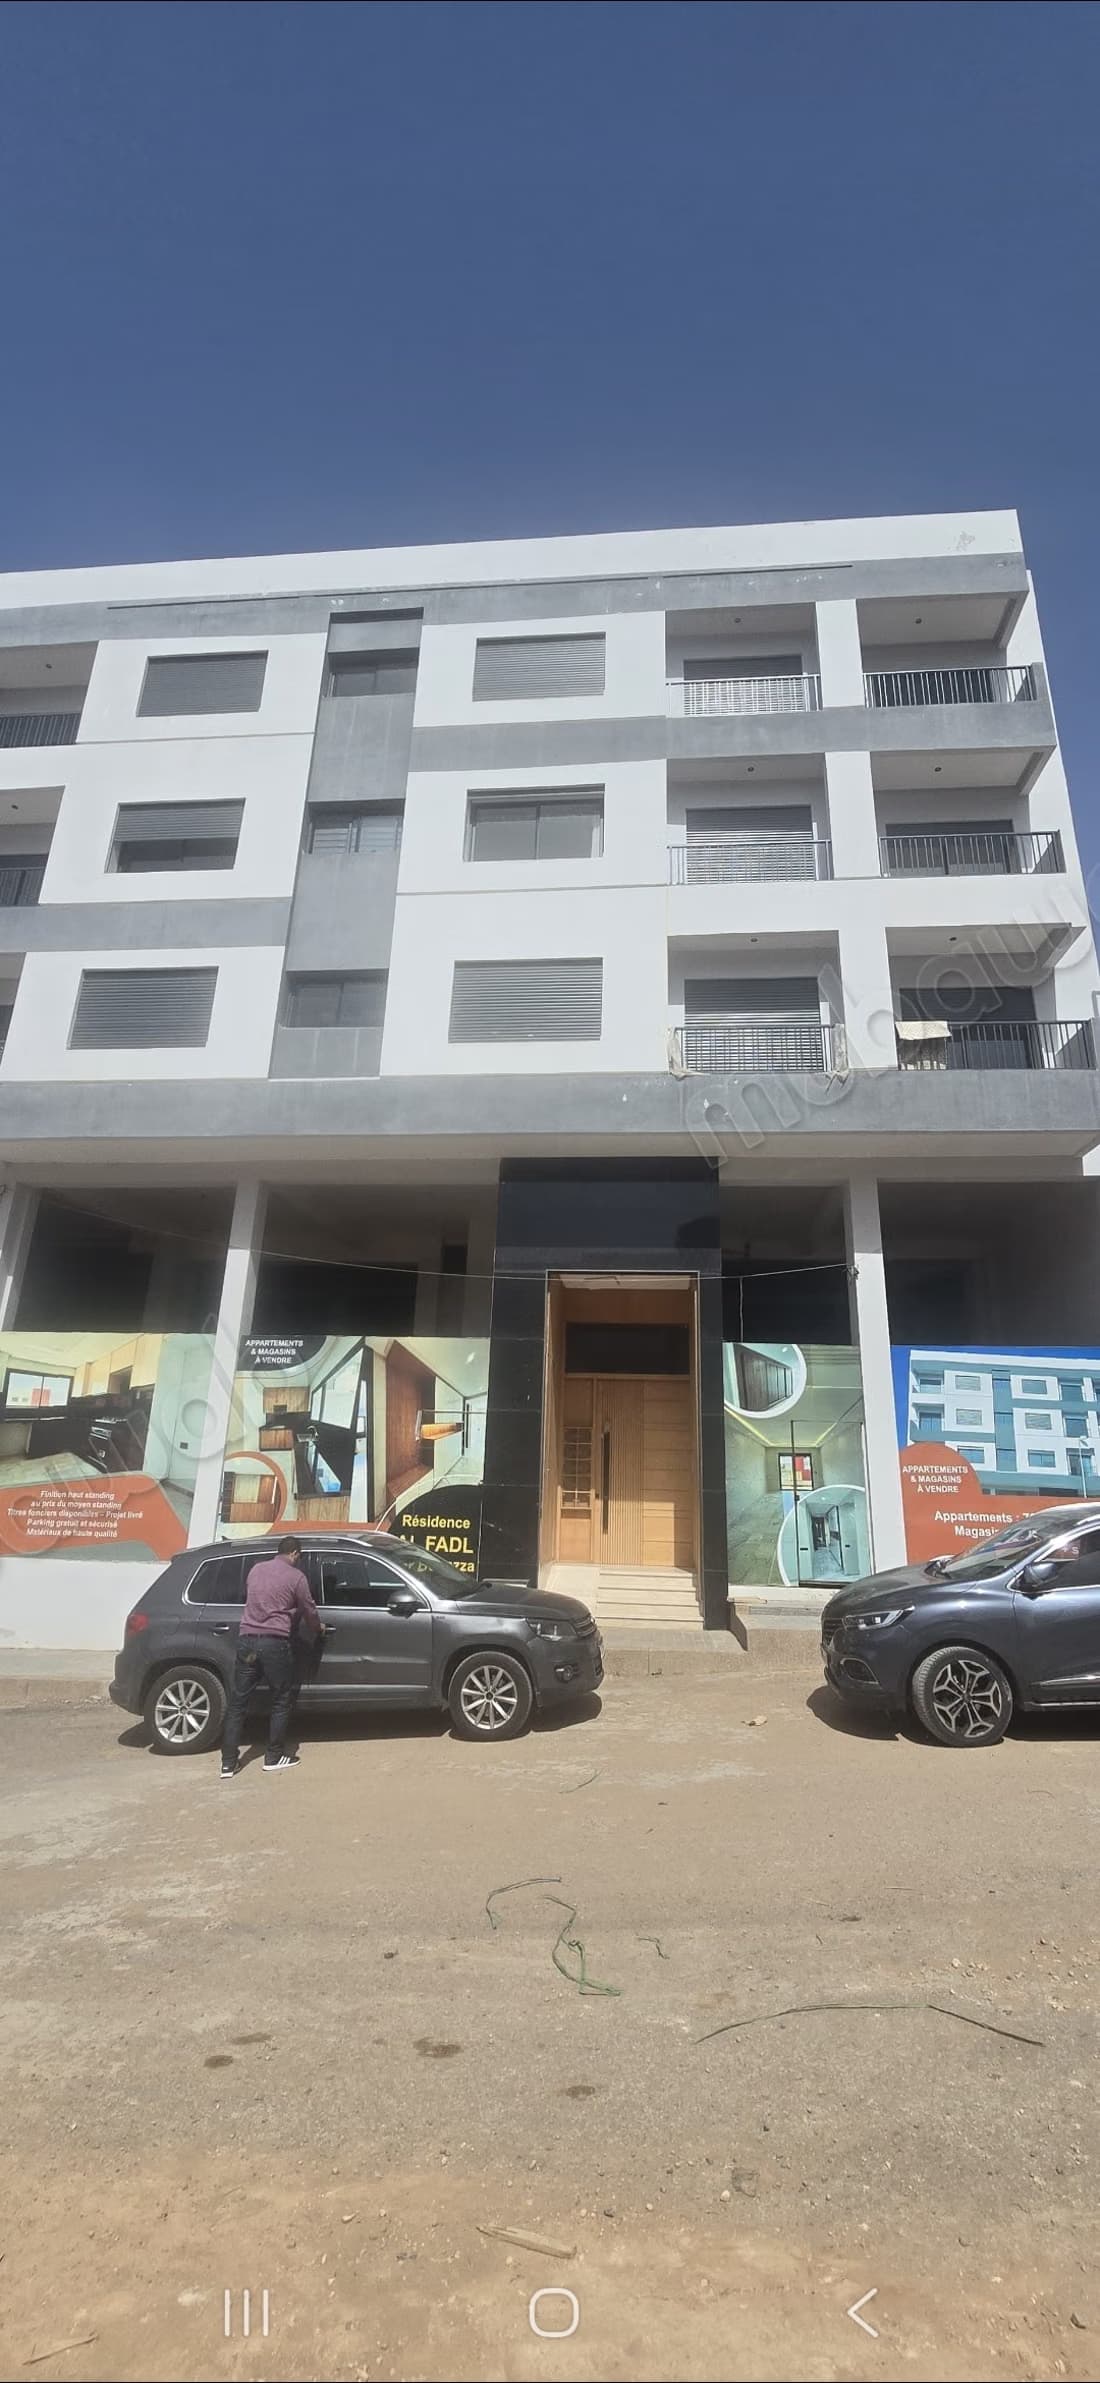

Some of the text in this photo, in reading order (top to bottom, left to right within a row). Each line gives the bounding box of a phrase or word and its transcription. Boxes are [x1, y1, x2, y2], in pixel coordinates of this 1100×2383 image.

[245, 1339, 304, 1347] APPARTEMENTS
[254, 1356, 261, 1364] À
[902, 1465, 968, 1474] APPARTEMENTS
[910, 1475, 962, 1483] & MAGASINS
[917, 1484, 960, 1493] À VENDRE
[84, 1492, 115, 1501] standing
[42, 1500, 56, 1509] prix
[67, 1501, 91, 1510] moyen
[92, 1502, 122, 1511] standing
[105, 1511, 126, 1520] Projet
[934, 1510, 1012, 1524] Appartements
[27, 1518, 55, 1528] Parking
[56, 1519, 79, 1528] gratuit
[402, 1514, 471, 1529] Résidence
[26, 1528, 61, 1536] Matériaux
[93, 1530, 118, 1538] qualité
[425, 1535, 474, 1554] FADL
